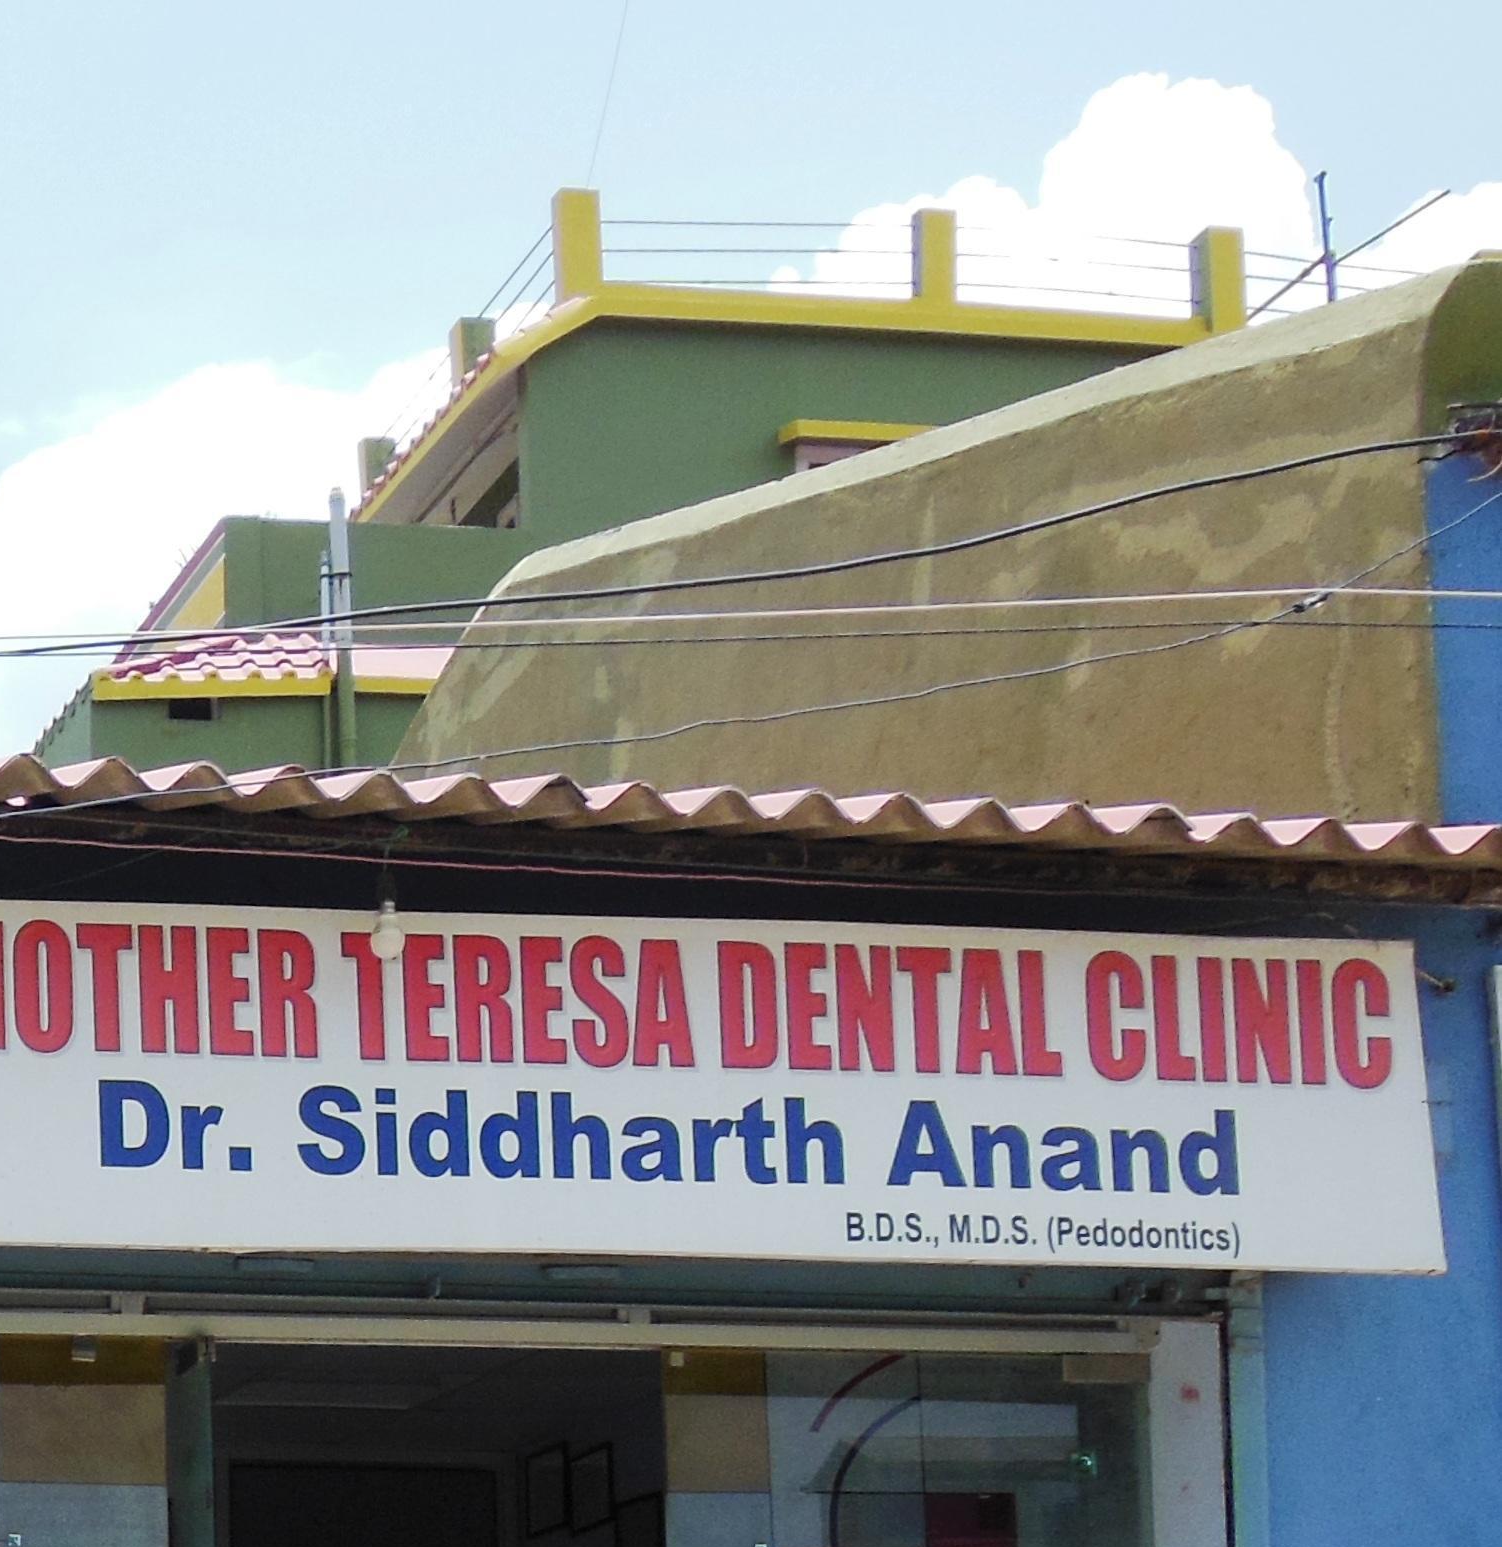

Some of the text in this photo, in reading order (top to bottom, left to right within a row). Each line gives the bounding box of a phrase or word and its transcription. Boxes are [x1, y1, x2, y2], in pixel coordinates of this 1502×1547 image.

[340, 931, 695, 1068] TERESA
[716, 940, 1064, 1078] DENTAL
[1085, 949, 1392, 1090] CLINIC
[97, 1079, 1240, 1197] Dr. Siddharth Anand
[846, 1211, 1241, 1259] B.D.S., M.D.S. (Pedodontics)
